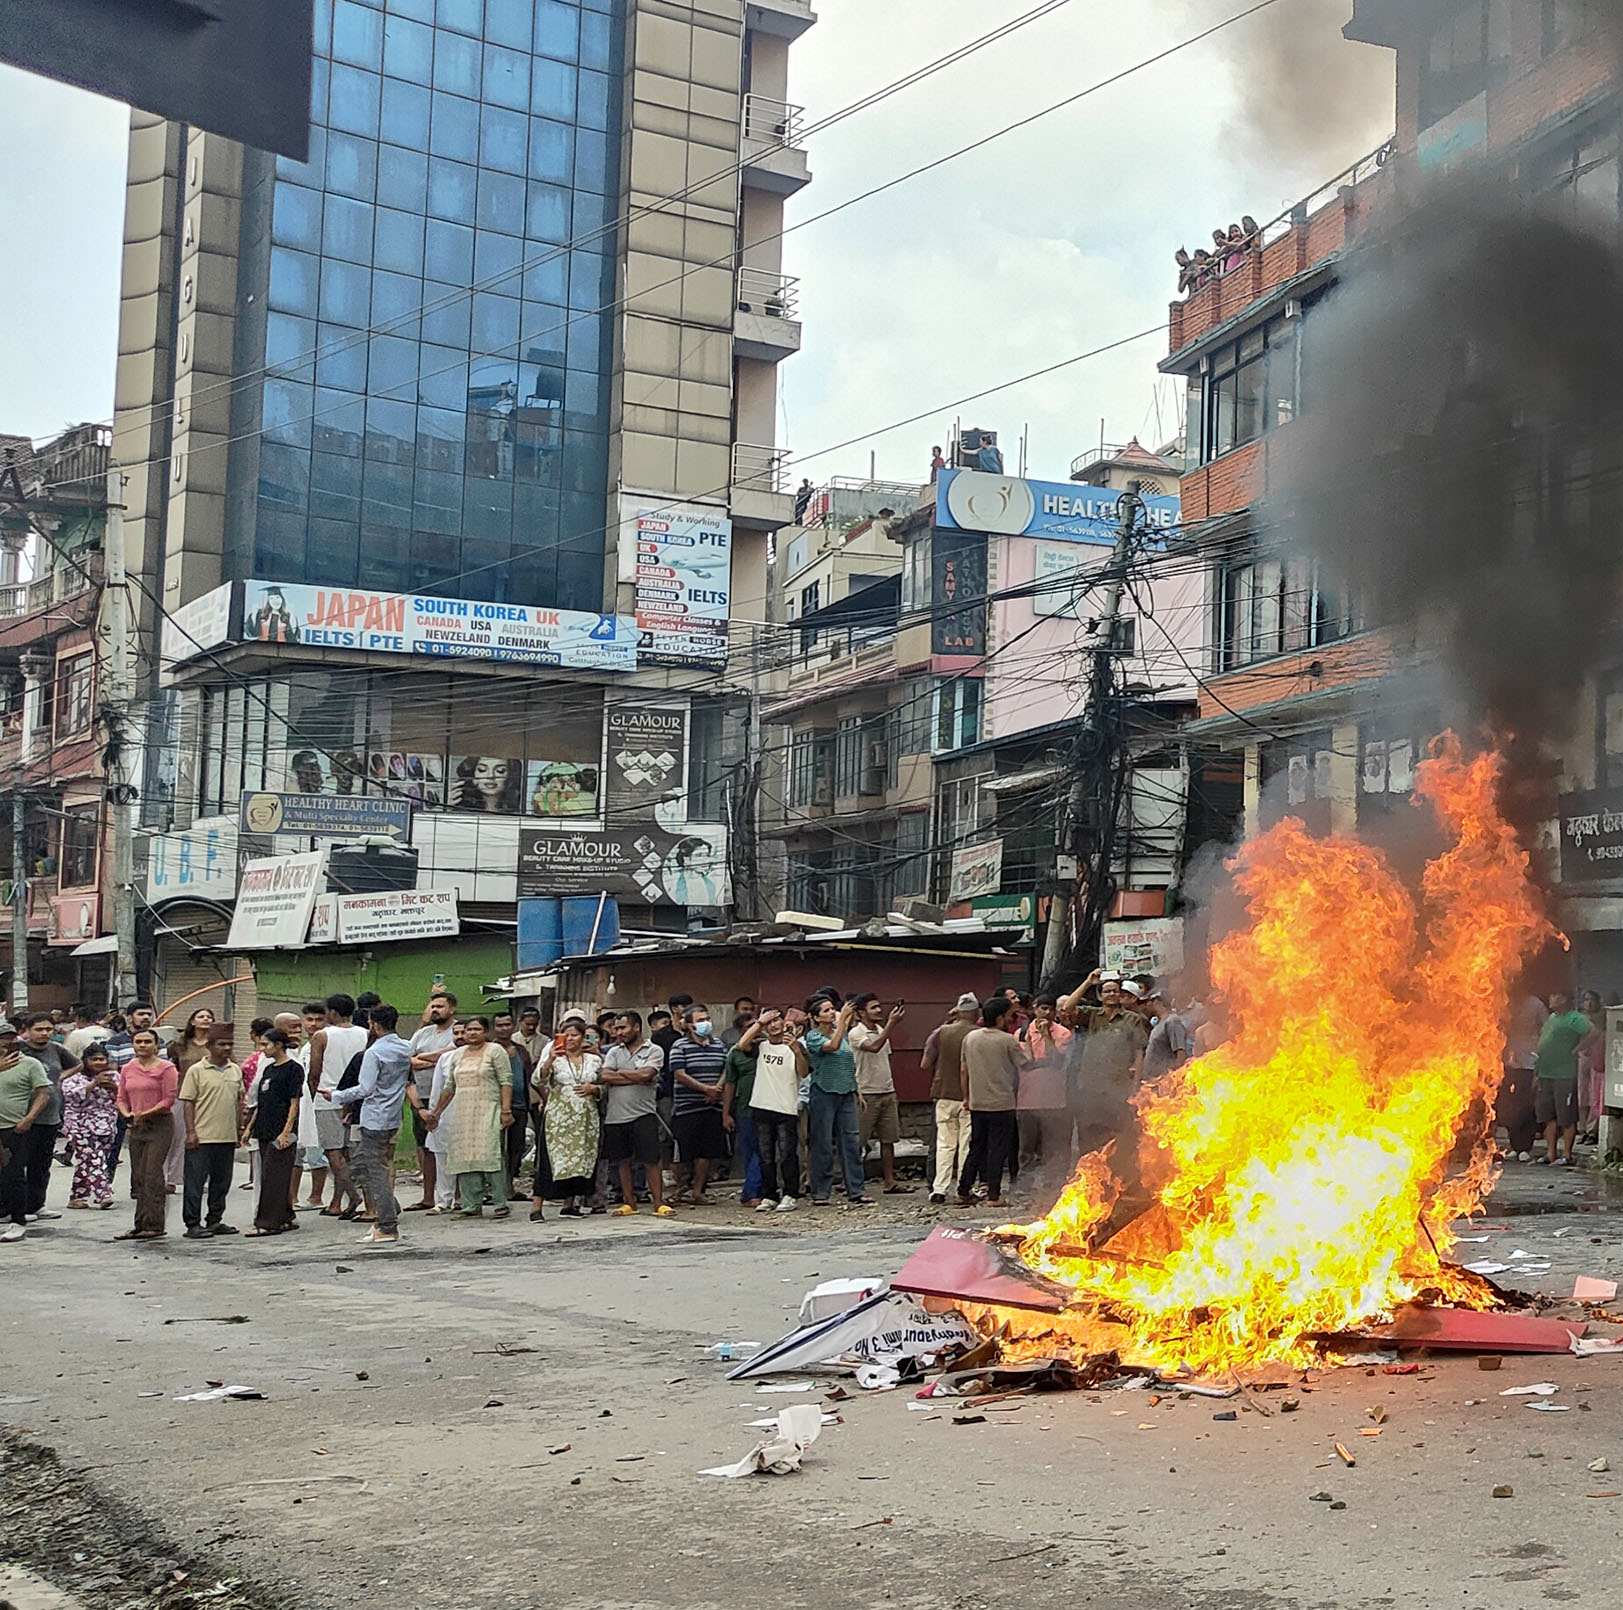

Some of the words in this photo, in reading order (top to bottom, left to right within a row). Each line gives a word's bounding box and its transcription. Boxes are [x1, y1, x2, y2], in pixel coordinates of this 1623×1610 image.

[640, 521, 667, 531] JAPAN
[686, 516, 720, 529] Working
[640, 532, 665, 543] SOUTH
[666, 535, 692, 546] KOREA
[700, 532, 727, 547] PTE
[640, 544, 651, 552] UK
[640, 554, 656, 564] USA
[639, 566, 672, 577] CANADA
[639, 577, 681, 590] AUSTRALIA
[638, 589, 677, 599] DENMARK
[688, 588, 727, 606] IELTS
[307, 591, 405, 632] JAPAN
[414, 598, 467, 616] SOUTH
[474, 604, 528, 622] KOREA
[536, 611, 560, 625] UK
[641, 612, 681, 622] Computer
[416, 615, 462, 629] CANADA
[470, 620, 492, 631] USA
[501, 623, 559, 638] AUSTRALIA
[305, 629, 354, 646] IELTS
[370, 634, 404, 650] PTE
[425, 629, 490, 644] NEWZELAND
[498, 636, 550, 650] DENMARK
[944, 636, 974, 647] LAB
[432, 646, 491, 657] 01-5924090
[611, 713, 681, 729] GLAMOUR
[284, 797, 332, 810] HEALTHY
[335, 799, 369, 812] HEART
[372, 801, 406, 813] CLINIC
[534, 840, 621, 857] GLAMOUR
[420, 894, 434, 904] कट
[763, 1054, 784, 1066] 1978
